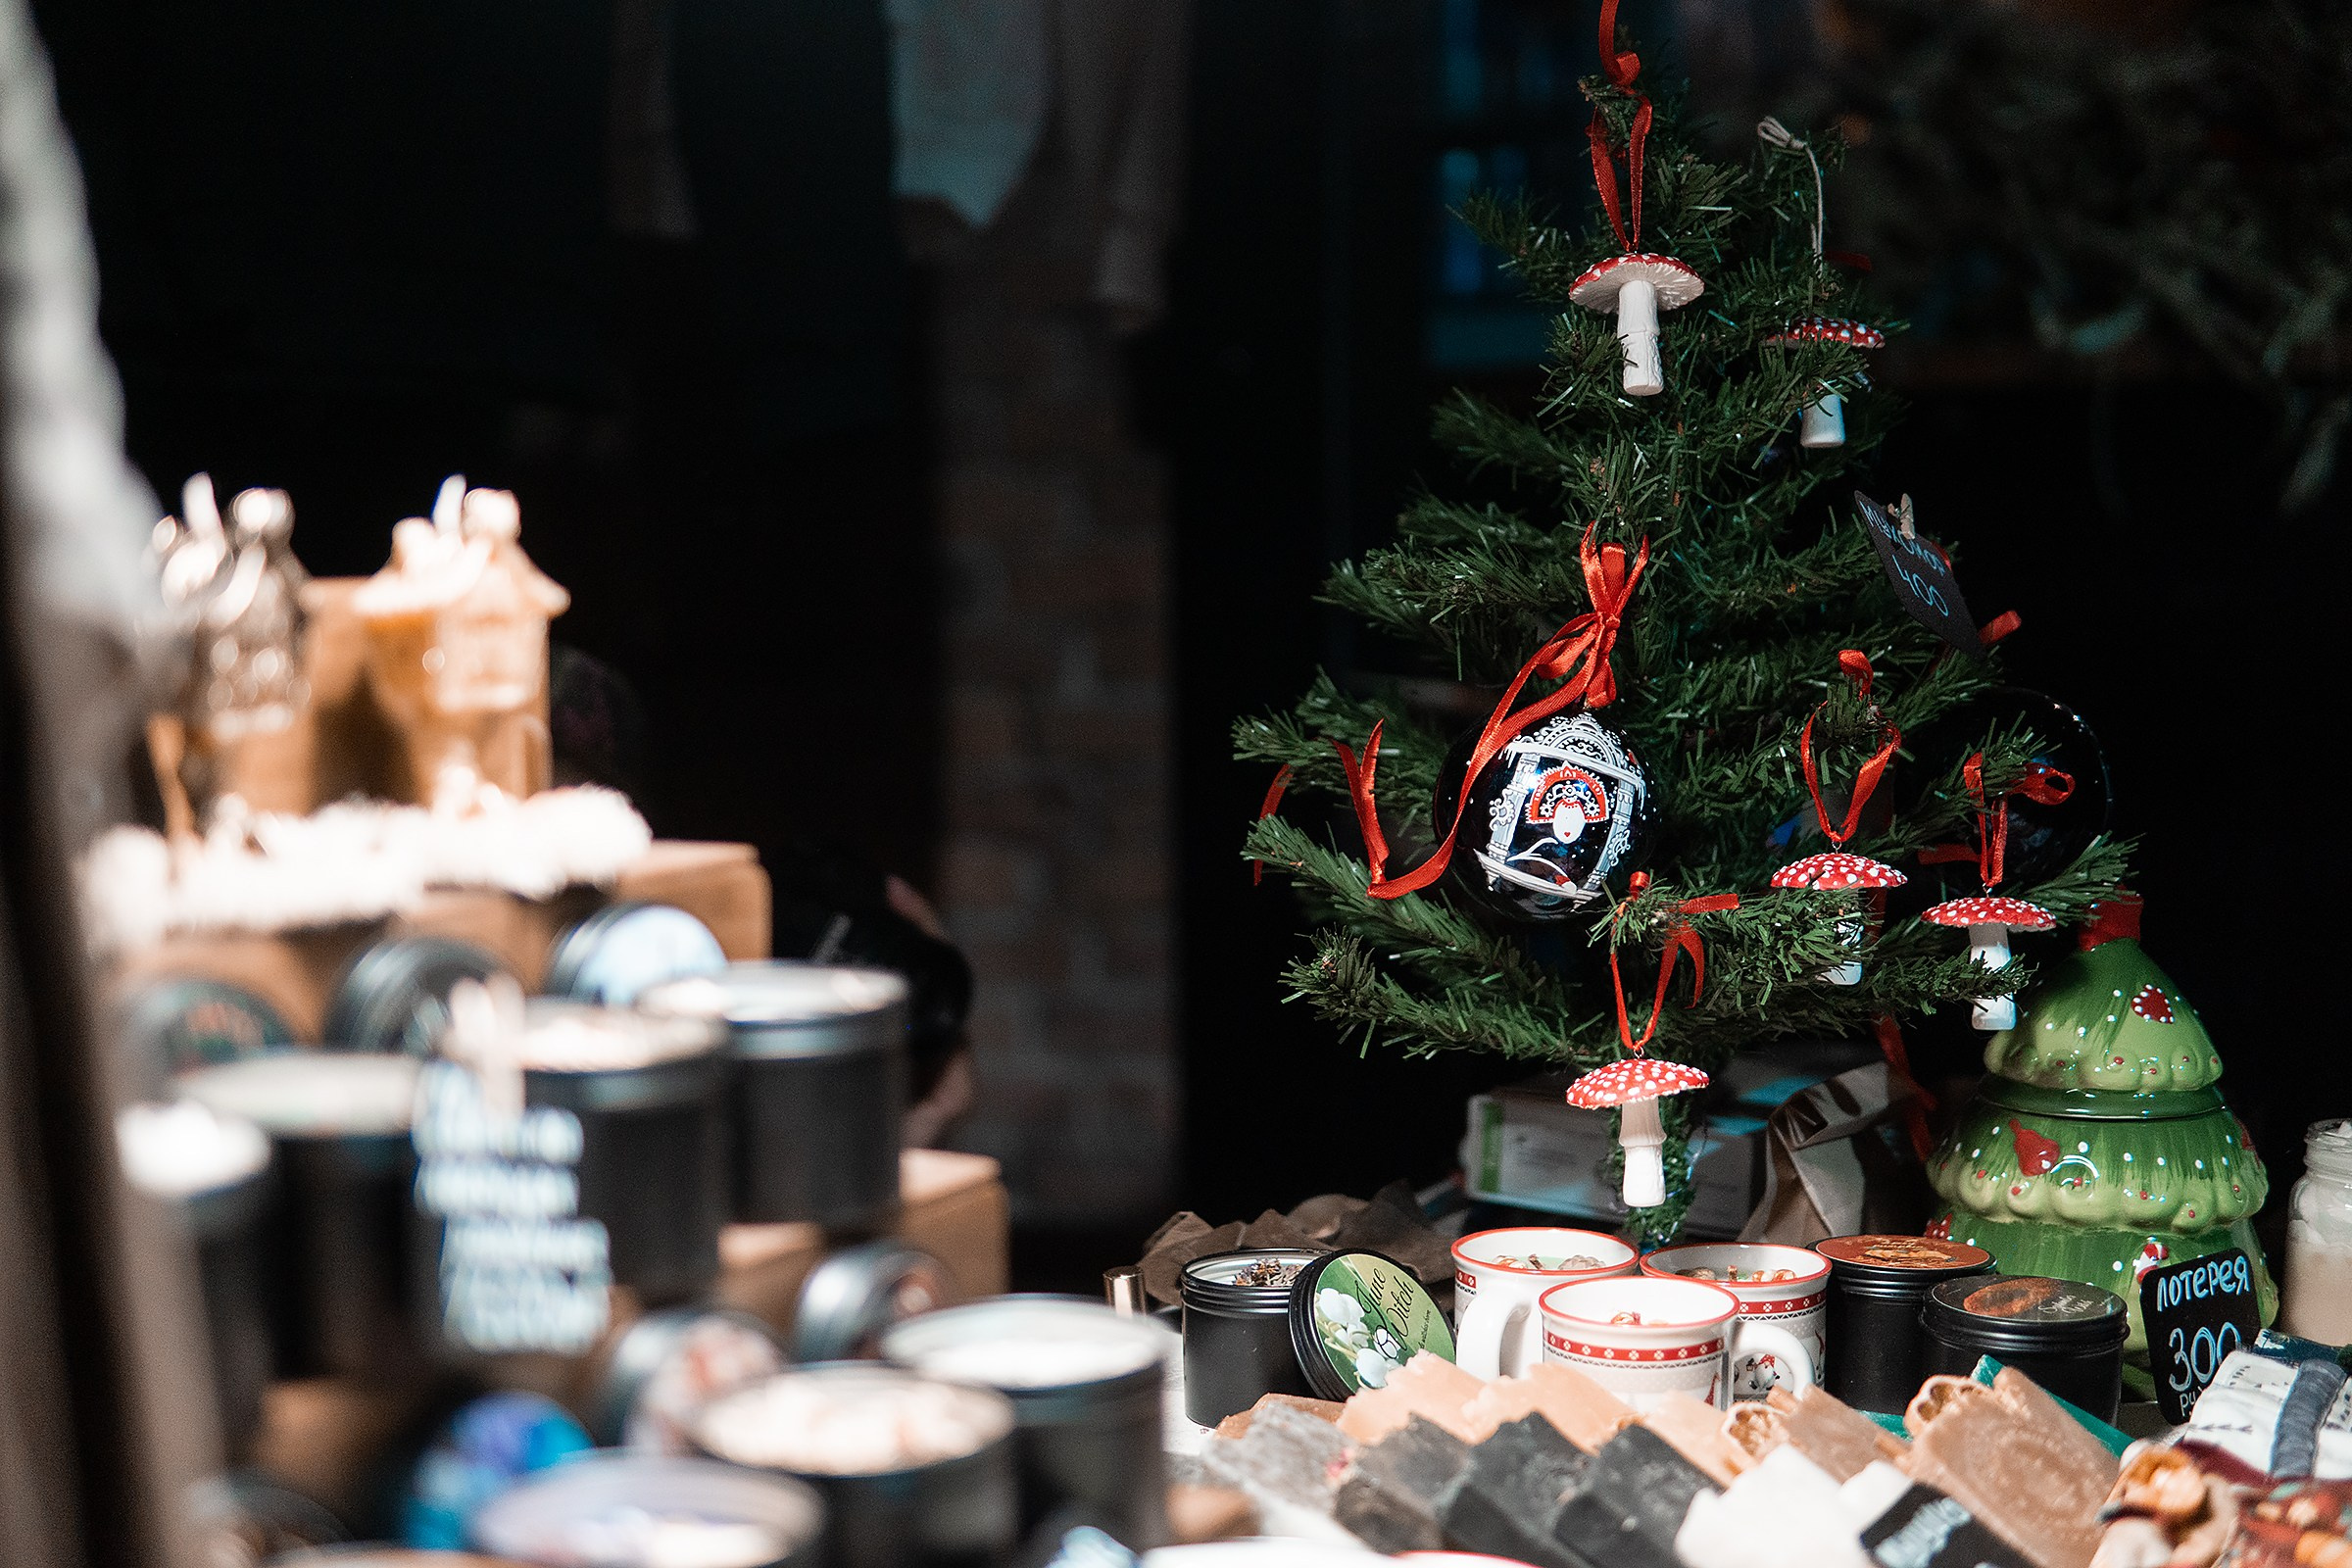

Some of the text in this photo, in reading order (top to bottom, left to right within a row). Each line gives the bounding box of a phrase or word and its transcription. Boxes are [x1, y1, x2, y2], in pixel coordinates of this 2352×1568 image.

[1891, 554, 1949, 617] 400
[1354, 1268, 1388, 1346] June
[1375, 1275, 1414, 1359] Witch
